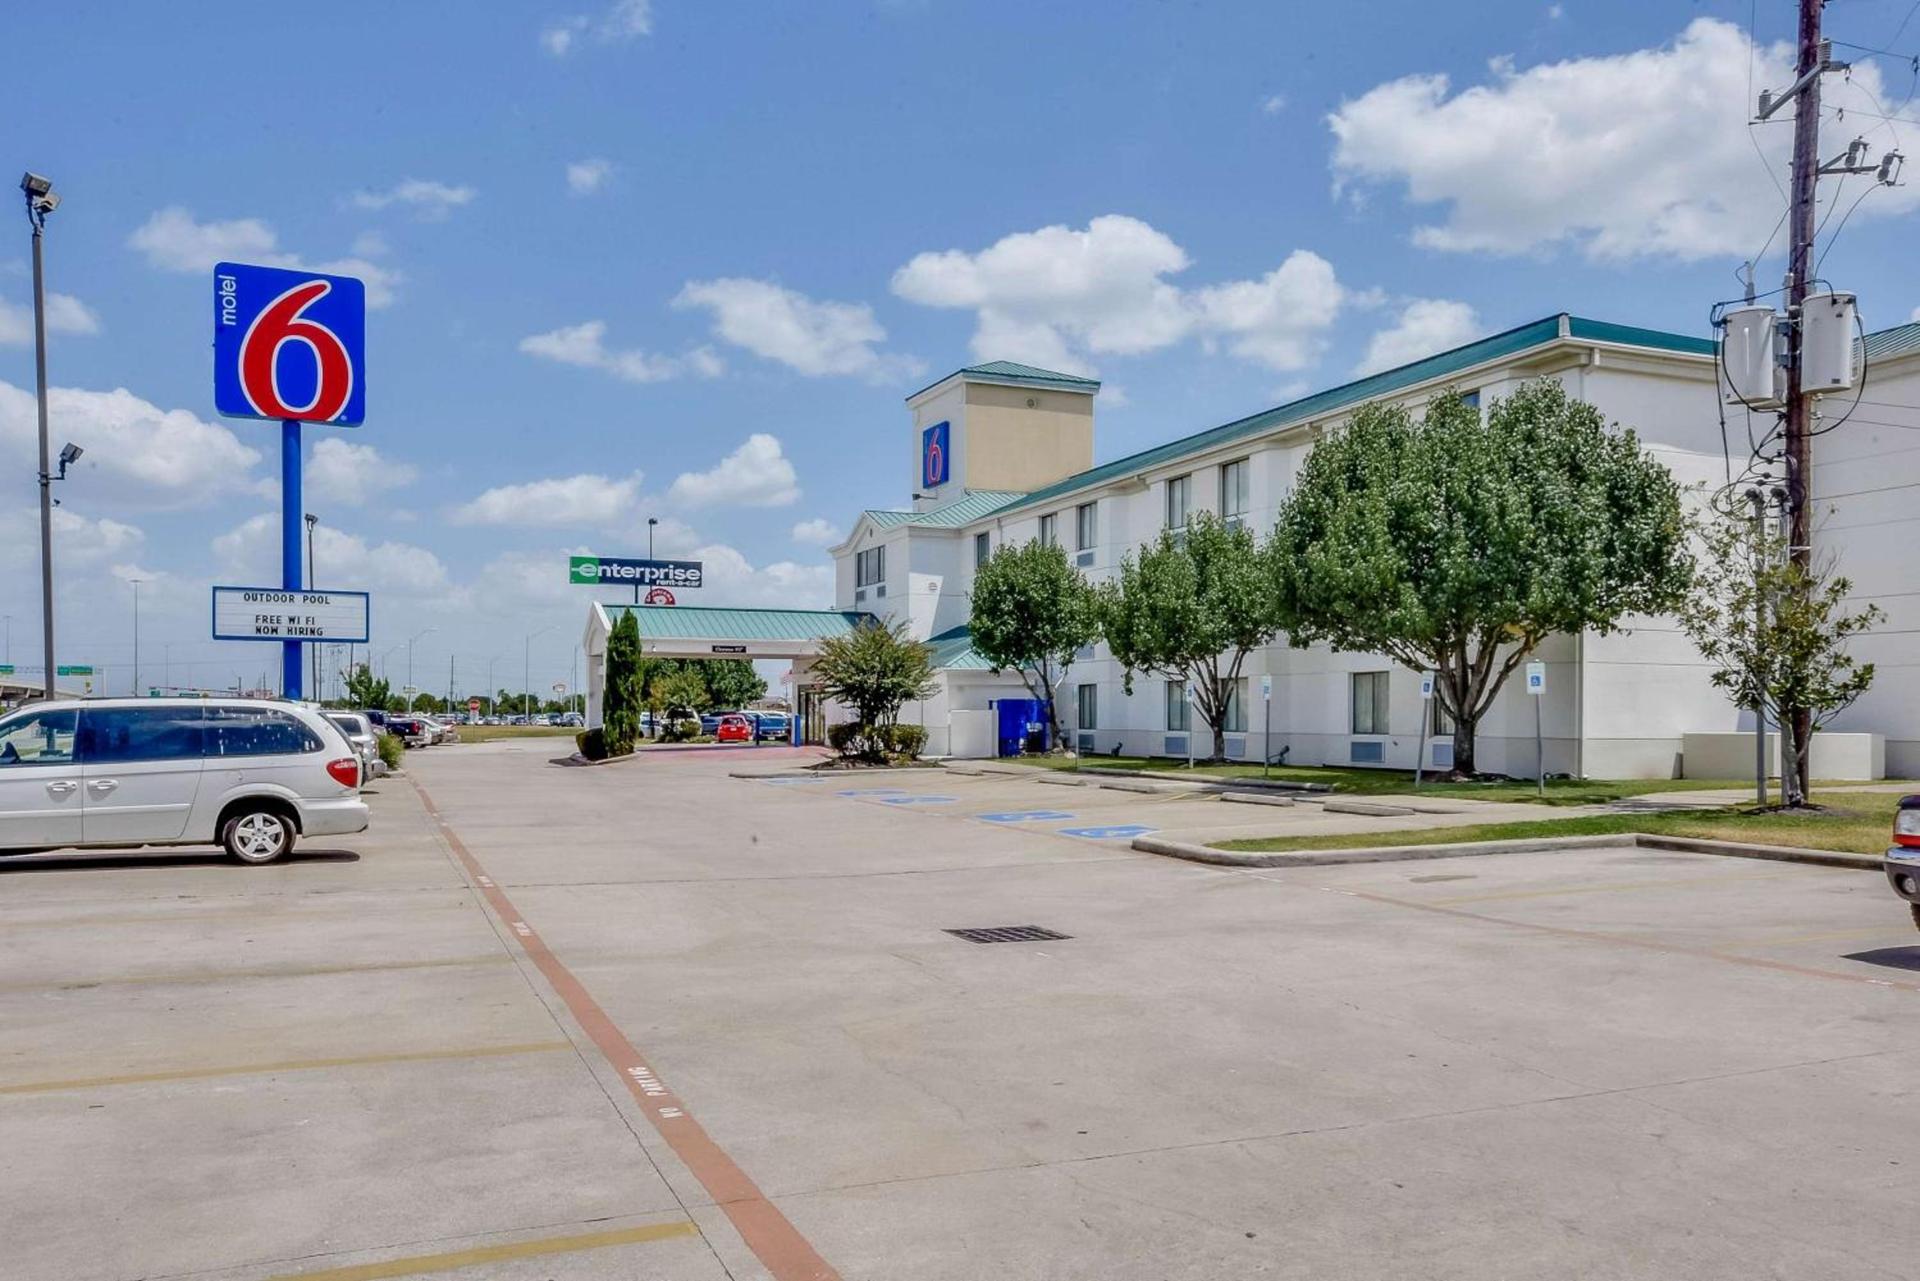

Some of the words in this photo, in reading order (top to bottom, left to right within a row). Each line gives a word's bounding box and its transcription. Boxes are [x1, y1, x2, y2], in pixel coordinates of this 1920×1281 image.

[217, 274, 236, 326] motel
[238, 279, 353, 422] 6
[927, 428, 943, 484] 6
[571, 563, 701, 583] enterprise
[656, 579, 701, 587] rent-a-car
[243, 592, 295, 603] OUTDOOR
[303, 595, 331, 605] POOL
[255, 615, 282, 625] FREE
[288, 615, 300, 625] WI
[305, 616, 315, 625] FI
[255, 626, 279, 635] NOW
[287, 626, 323, 636] HIRING
